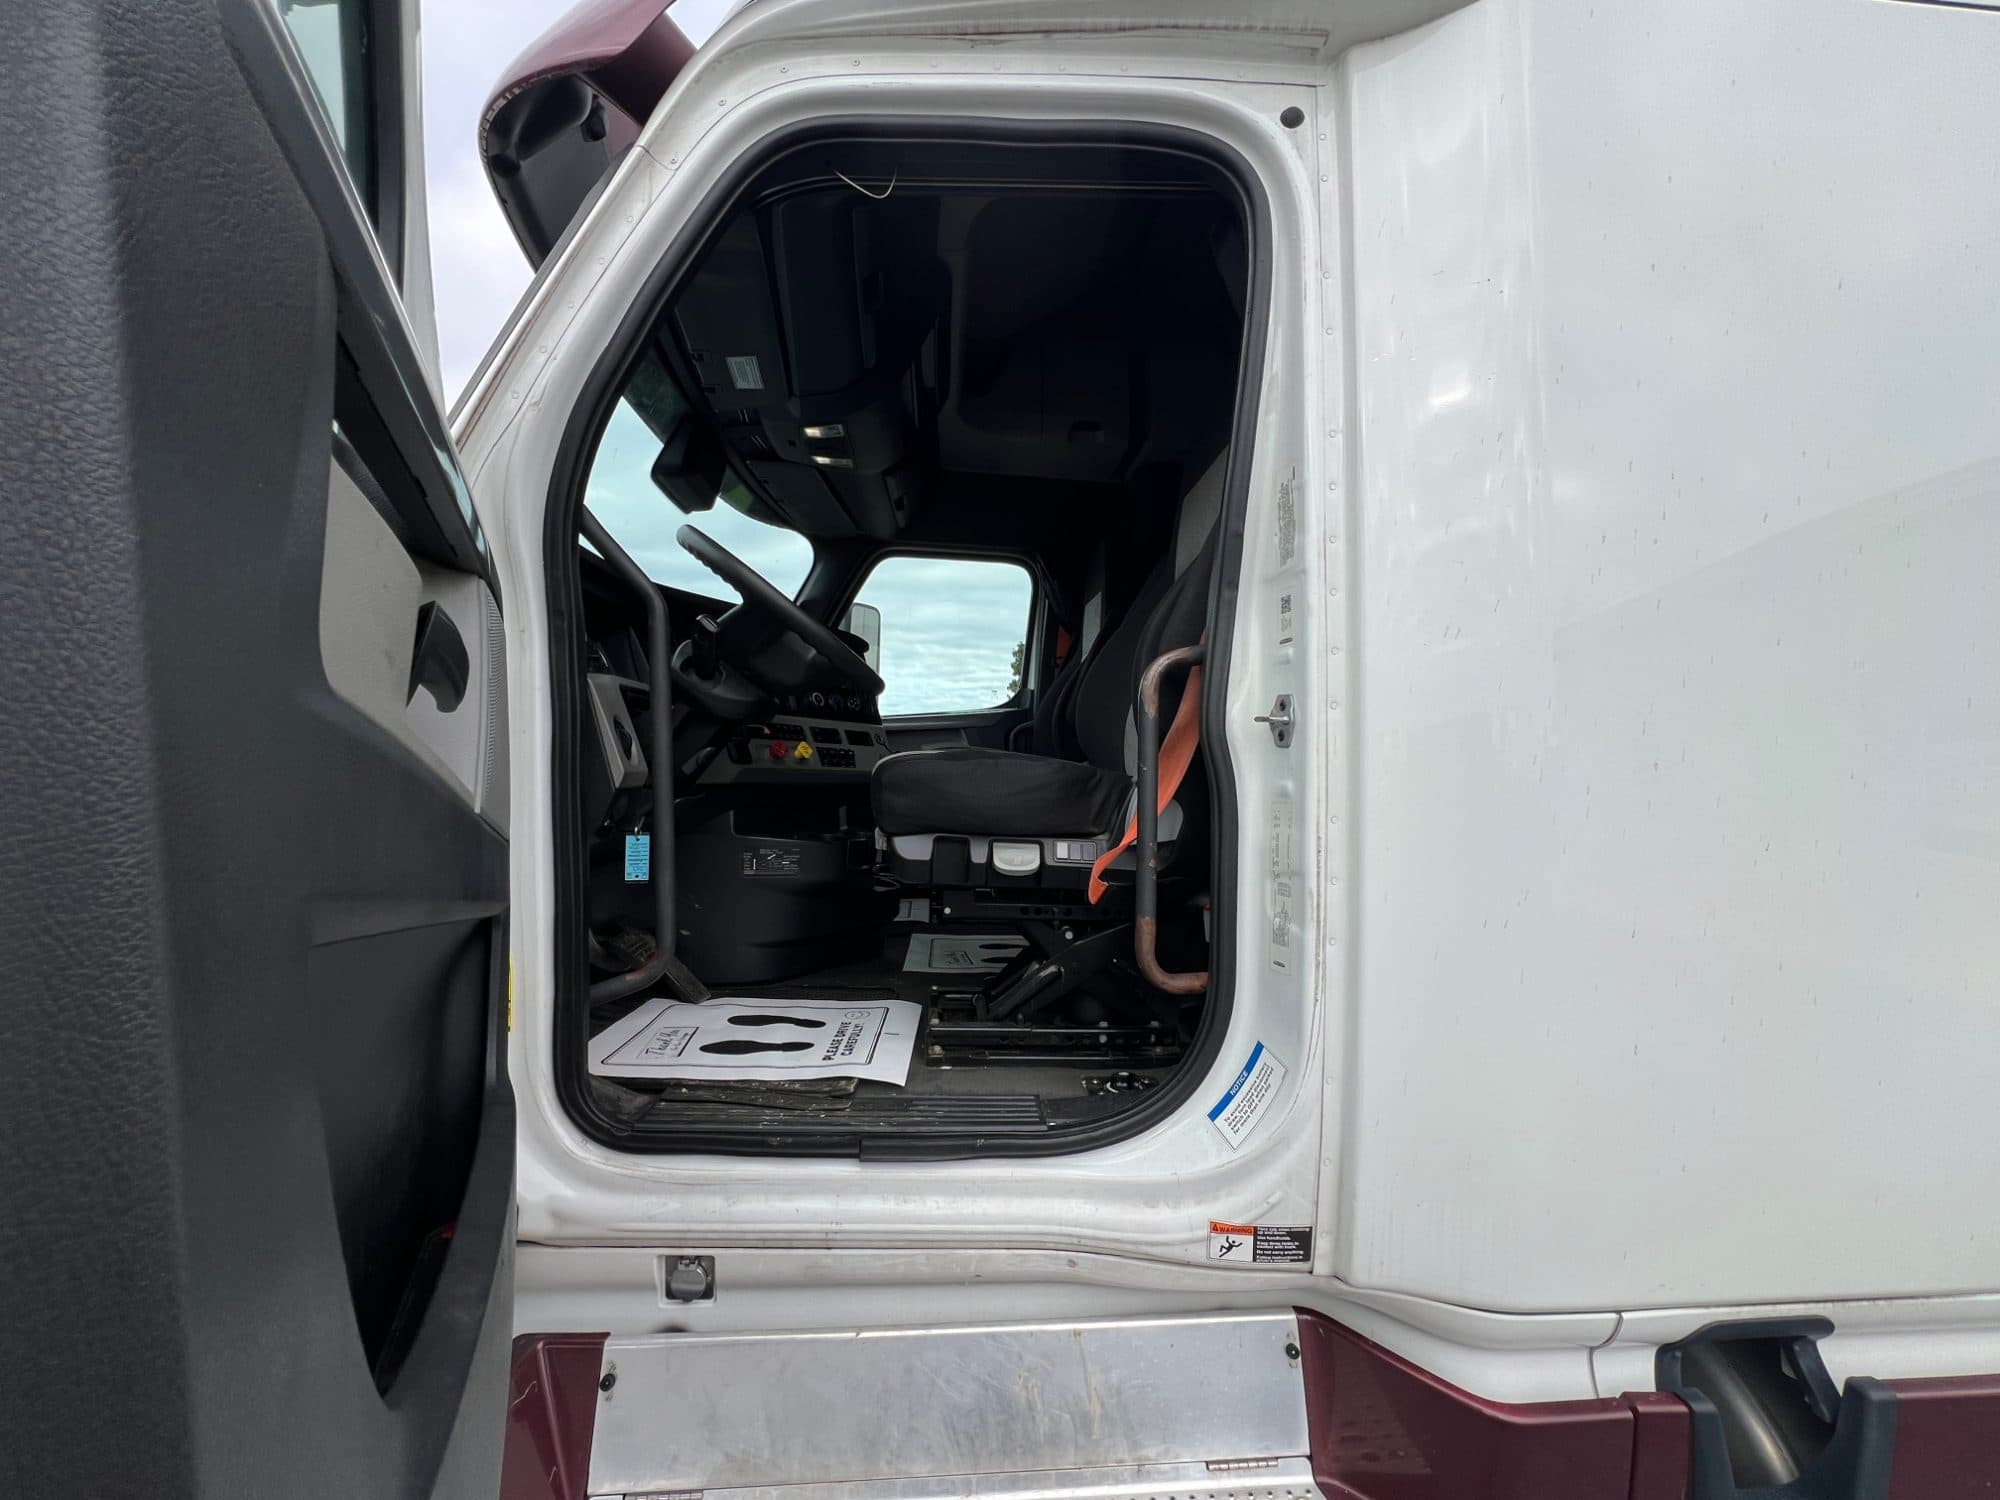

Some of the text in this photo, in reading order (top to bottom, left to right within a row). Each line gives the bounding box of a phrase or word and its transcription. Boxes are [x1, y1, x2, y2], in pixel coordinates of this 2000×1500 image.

[822, 1021, 852, 1061] PLEASE DRIVE
[1230, 1070, 1248, 1096] NOTICE
[1230, 1103, 1241, 1117] avoid
[1219, 1225, 1252, 1234] WARNING
